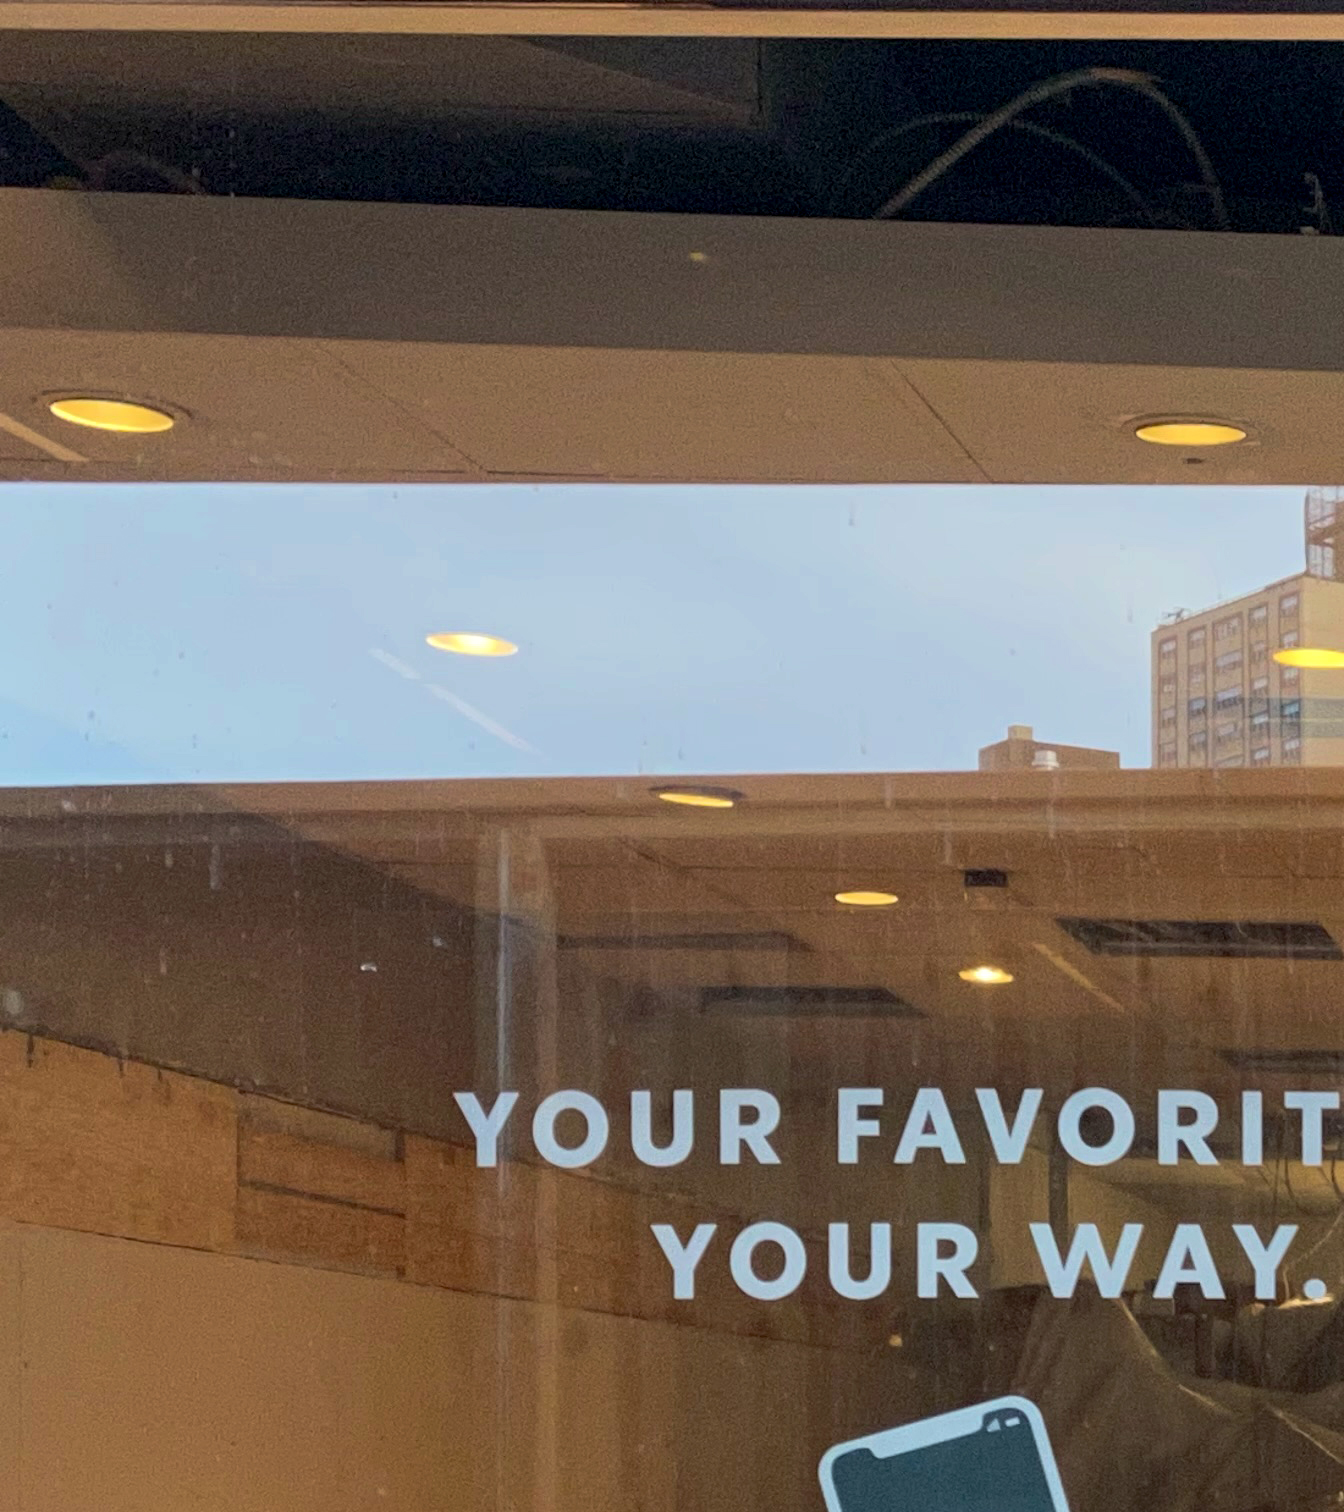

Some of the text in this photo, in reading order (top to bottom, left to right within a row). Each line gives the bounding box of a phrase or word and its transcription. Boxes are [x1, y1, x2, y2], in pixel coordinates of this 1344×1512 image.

[453, 1089, 781, 1168] YOUR
[651, 1221, 1330, 1302] YOUR WAY.
